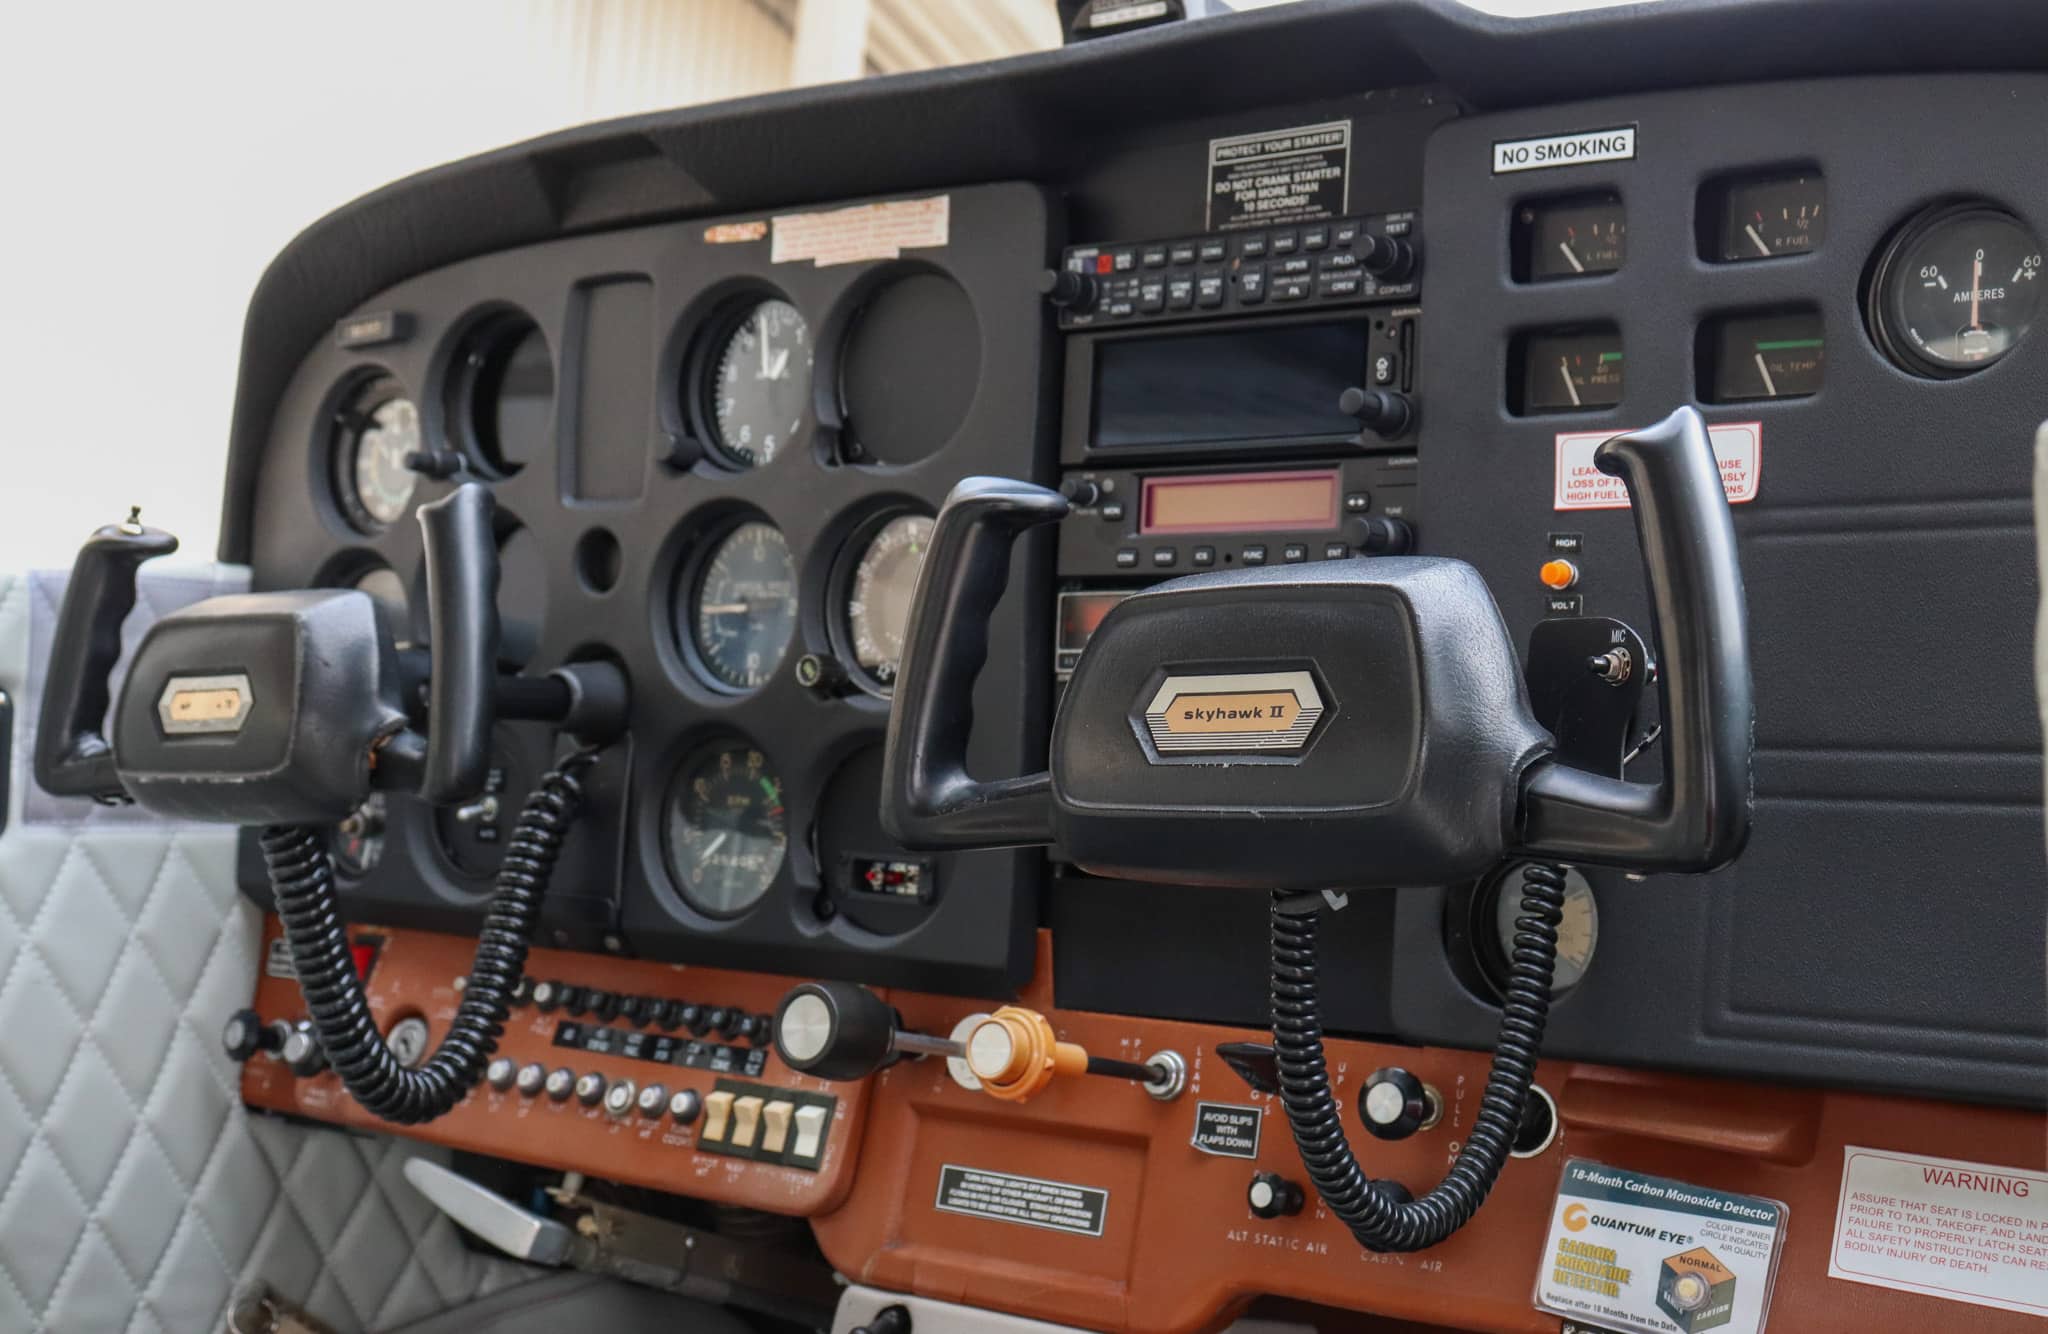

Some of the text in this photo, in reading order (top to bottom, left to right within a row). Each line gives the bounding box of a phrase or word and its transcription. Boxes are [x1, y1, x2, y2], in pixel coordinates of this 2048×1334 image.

[1216, 144, 1262, 158] PROTECT
[1264, 139, 1292, 152] YOUR
[1502, 136, 1626, 164] NO SMOKING
[1215, 182, 1231, 194] DO
[1232, 178, 1253, 191] NOT
[1255, 174, 1291, 189] CRANK
[1293, 167, 1341, 182] STARTER
[1235, 181, 1319, 202] FOR MORE THAN
[1976, 249, 1984, 260] 0
[2023, 255, 2041, 268] 60
[1920, 265, 1938, 278] 60
[1720, 459, 1742, 469] USE
[1568, 480, 1594, 489] LOSS
[1597, 479, 1611, 487] OF
[1567, 491, 1591, 500] HIGH
[1594, 490, 1619, 499] FUEL
[1555, 538, 1577, 547] HIGH
[1243, 551, 1262, 560] FUNC
[1611, 629, 1626, 643] MIC
[1184, 705, 1285, 722] skyhawk II
[1203, 1112, 1253, 1126] AVOID SLIPS
[1216, 1126, 1238, 1135] WITH
[1199, 1136, 1252, 1148] FLAPS DOWN
[1923, 1167, 2029, 1198] WARNING
[1572, 1169, 1774, 1220] 18-Month Carbon Monoxide Detector
[1851, 1192, 1897, 1207] ASSURE
[1900, 1199, 1927, 1212] THAT
[1930, 1204, 1957, 1217] SEAT
[1961, 1210, 1973, 1219] IS
[1975, 1212, 2023, 1228] LOCKED
[2026, 1220, 2038, 1230] IN
[1590, 1215, 1656, 1237] QUANTUM
[1705, 1220, 1771, 1241] COLOR OF INNER
[1850, 1204, 1885, 1218] PRIOR
[1887, 1210, 1902, 1220] TO
[1990, 1227, 2016, 1239] AND
[2018, 1230, 2048, 1245] LAND
[1227, 1230, 1250, 1245] ALT
[1306, 1238, 1329, 1256] AIR
[1700, 1229, 1769, 1250] CIRCLE INDICATES
[1848, 1216, 1893, 1231] FAILURE
[1897, 1224, 1912, 1235] TO
[1914, 1228, 1975, 1245] PROPERLY
[1977, 1238, 2015, 1252] LATCH
[1559, 1238, 1616, 1264] CARBON
[1720, 1243, 1767, 1259] AIR QUALITY
[1844, 1240, 1888, 1255] BODILY
[1886, 1248, 1926, 1263] INJURY
[1929, 1254, 1946, 1266] OR
[1846, 1228, 1865, 1240] ALL
[1867, 1233, 1911, 1247] SAFETY
[1914, 1239, 1999, 1262] INSTRUCTIONS
[2002, 1255, 2027, 1268] CAN
[1420, 1261, 1442, 1272] AIR
[1680, 1256, 1721, 1272] NORMAL
[1546, 1292, 1572, 1305] Replace
[1575, 1300, 1590, 1309] after
[1603, 1306, 1628, 1319] Months
[1630, 1314, 1646, 1323] from
[1648, 1317, 1659, 1327] the
[1661, 1321, 1677, 1332] Date
[1696, 1304, 1730, 1320] CAUTION
